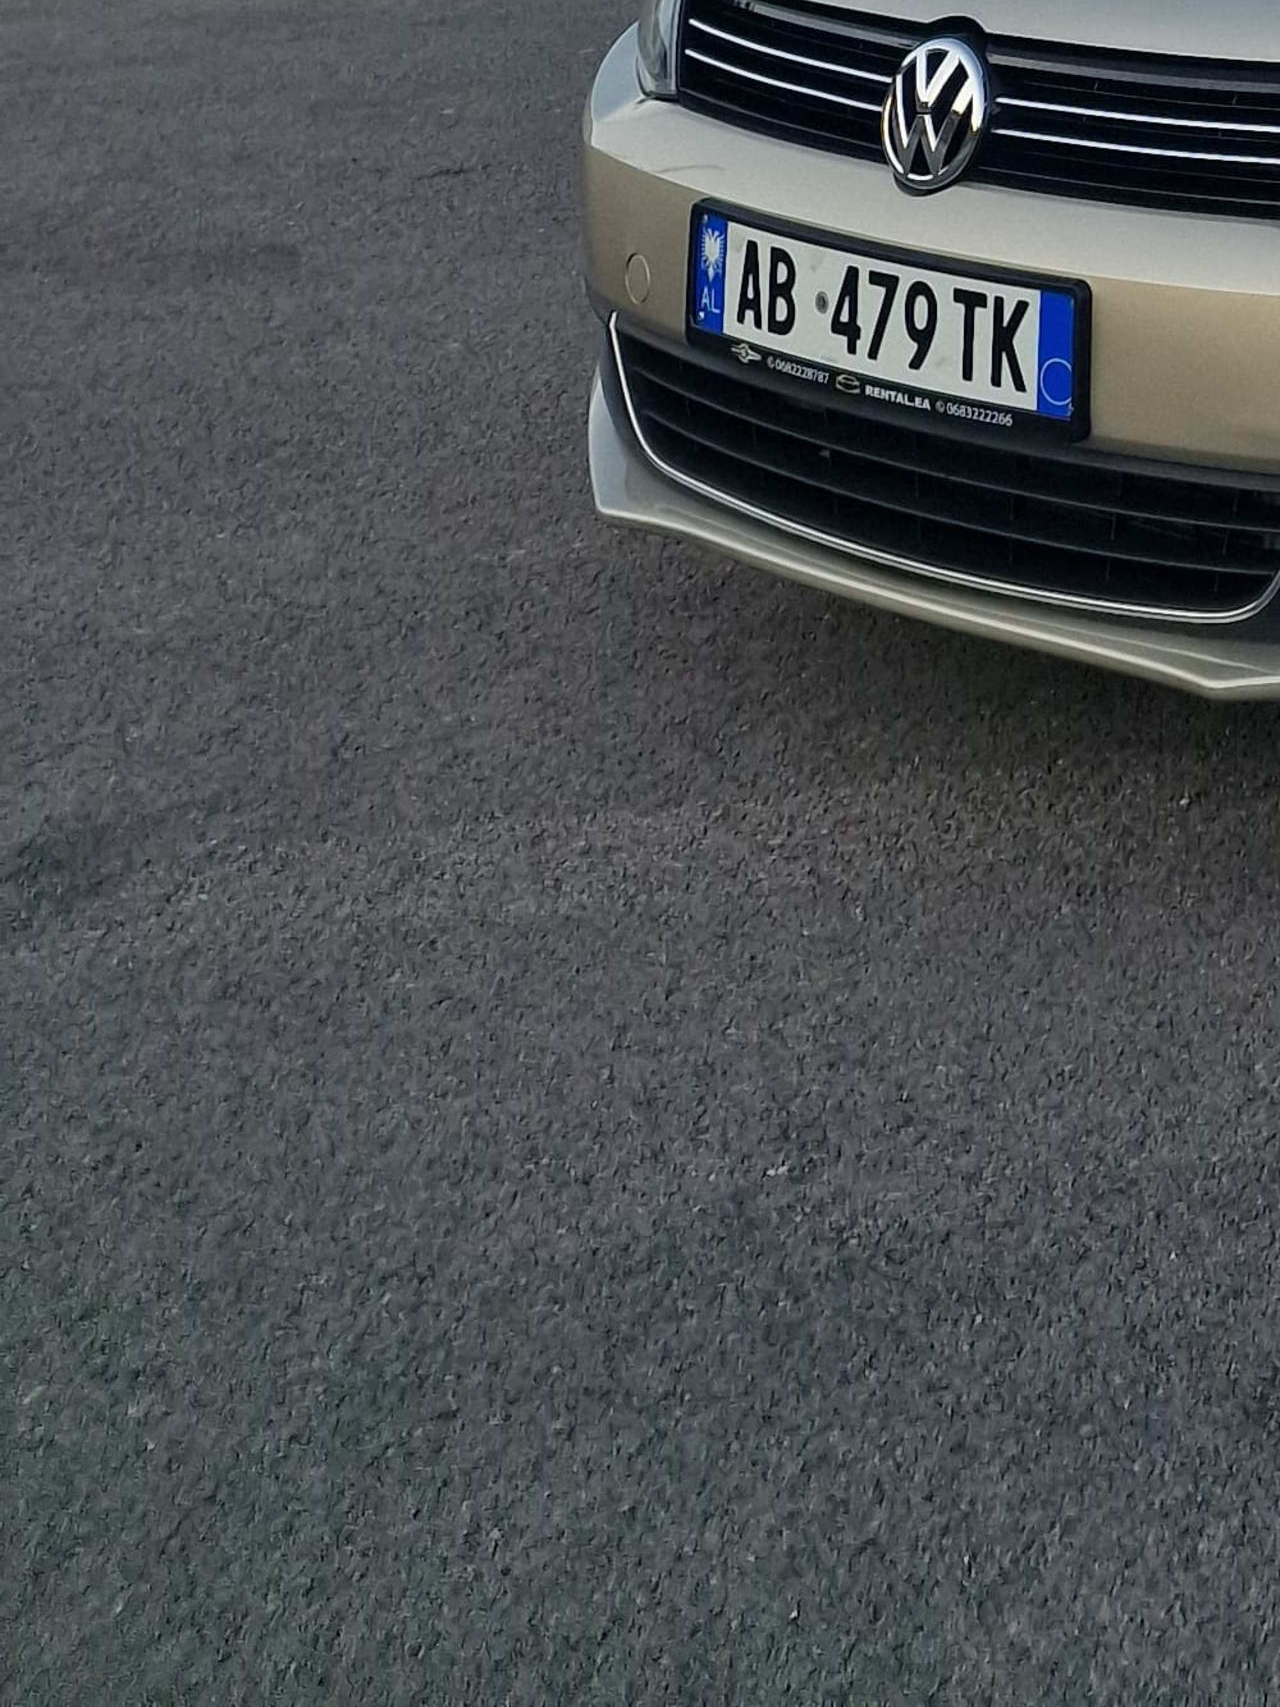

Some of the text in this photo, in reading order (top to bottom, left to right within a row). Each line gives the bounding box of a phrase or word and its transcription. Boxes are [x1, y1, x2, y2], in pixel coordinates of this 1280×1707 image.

[700, 285, 721, 314] AL
[736, 238, 1030, 393] AB 479 TK
